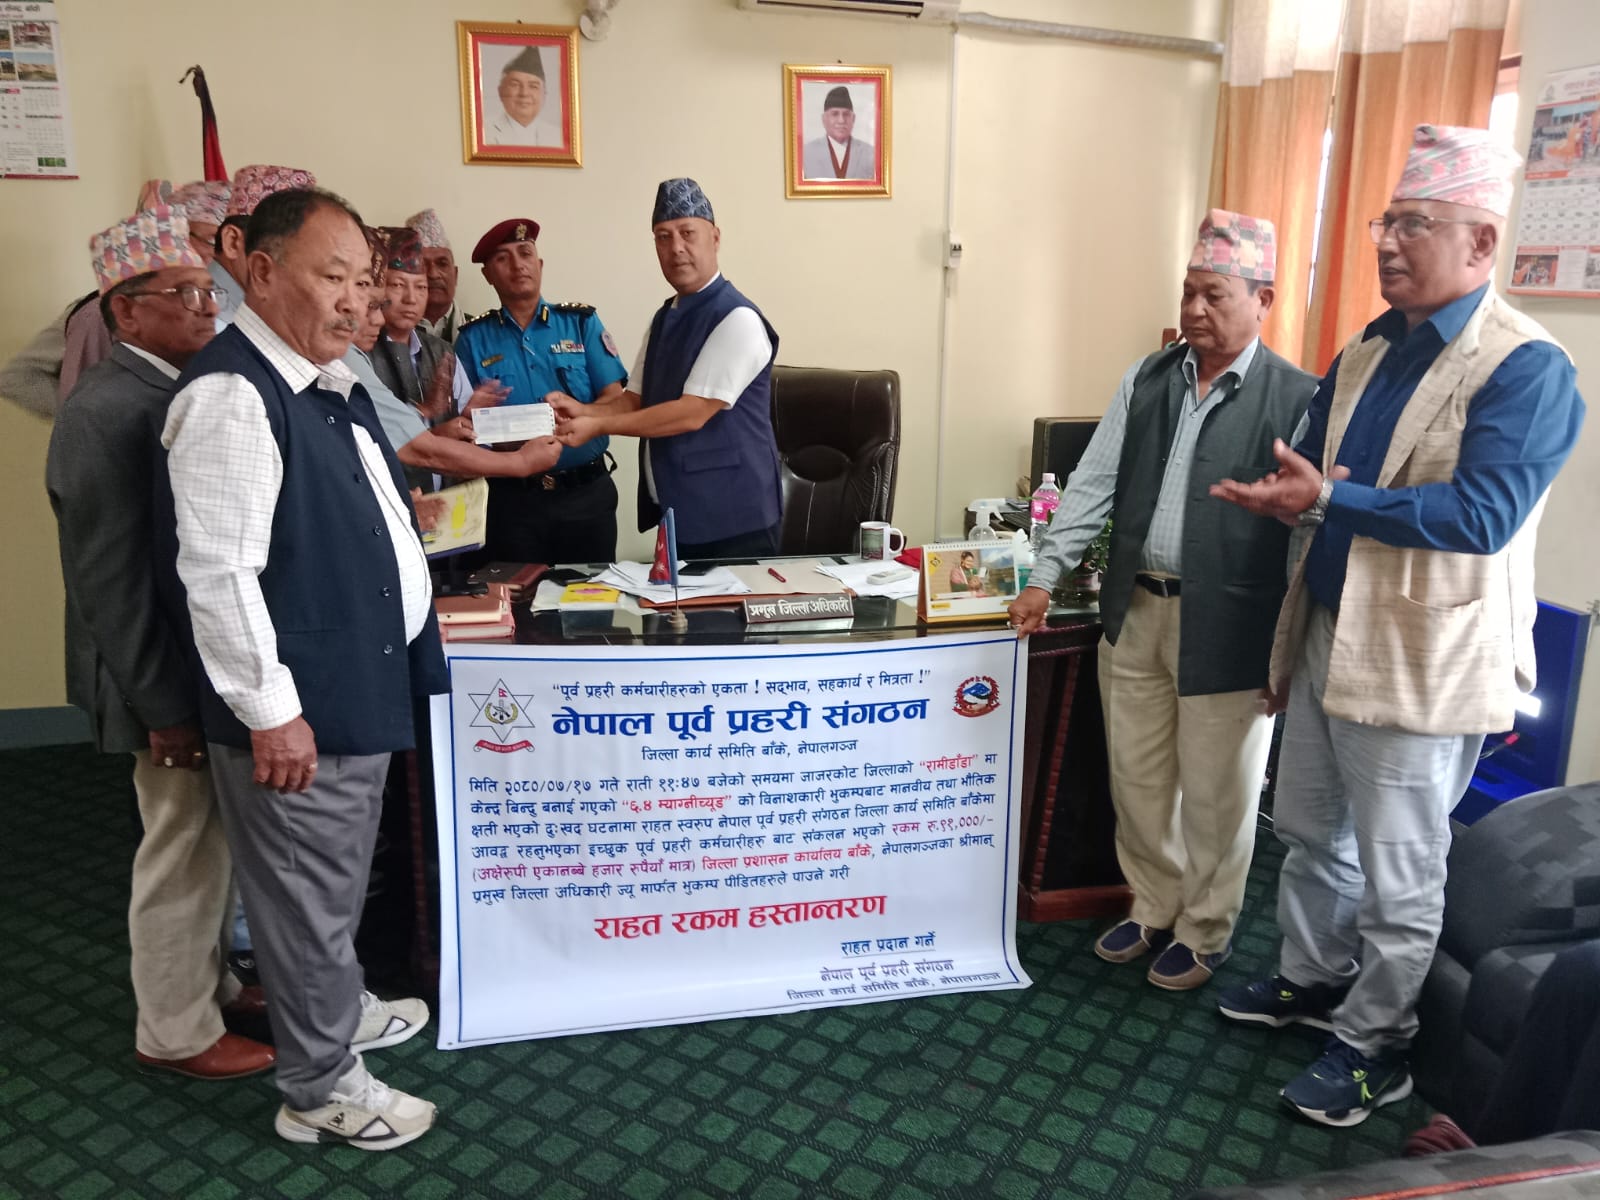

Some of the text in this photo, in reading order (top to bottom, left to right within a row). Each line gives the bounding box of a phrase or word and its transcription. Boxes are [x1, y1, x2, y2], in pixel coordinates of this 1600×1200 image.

[749, 597, 849, 619] प्रमुख जिल्ला अधिकारी
[585, 681, 615, 698] प्रहरी
[621, 681, 706, 698] कर्मचारीहरुको
[712, 683, 748, 698] एकता
[818, 673, 862, 692] सहकार्य
[867, 676, 875, 688] र
[880, 671, 913, 686] मित्रता
[552, 698, 930, 740] नेपाल पूर्व प्रहरी संगठन
[642, 739, 858, 761] जिल्ला कार्य समिति बाँके, नेपालगञ्ज
[469, 777, 498, 793] मिति
[505, 779, 591, 796] २०८०/०७/१७
[600, 777, 620, 792] गते
[627, 775, 653, 792] राती
[659, 776, 700, 792] ११:४७
[708, 772, 745, 787] बजेको
[752, 772, 795, 787] समयमा
[800, 765, 859, 782] जाजरकोट
[864, 760, 914, 777] जिल्लाको
[985, 753, 998, 765] मा
[471, 799, 501, 815] केन्द्र
[506, 799, 537, 817] बिन्दु
[542, 798, 575, 814] बनाई
[580, 798, 617, 815] गएको
[738, 792, 755, 806] को
[759, 787, 826, 806] विनाशकारी
[830, 785, 886, 803] भुकम्पबाट
[890, 779, 932, 795] मानवीय
[936, 778, 958, 790] तथा
[961, 772, 997, 787] भौतिक
[472, 820, 498, 838] क्षती
[503, 820, 540, 838] भएको
[588, 821, 637, 834] घटनामा
[642, 820, 672, 834] राहत
[677, 818, 714, 832] स्वरुप
[718, 814, 752, 829] नेपाल
[756, 811, 775, 829] पूर्व
[779, 808, 807, 825] प्रहरी
[812, 807, 851, 823] संगठन
[855, 803, 889, 818] जिल्ला
[893, 798, 919, 813] कार्य
[922, 795, 957, 813] समिति
[960, 791, 996, 806] बाँकेमा
[516, 844, 581, 860] रहनुभएका
[588, 842, 629, 858] इच्छुक
[636, 838, 655, 857] पूर्व
[662, 836, 692, 853] प्रहरी
[699, 833, 766, 850] कर्मचारीहरु
[773, 833, 796, 845] बाट
[802, 828, 846, 844] संकलन
[853, 822, 886, 840] भएको
[892, 822, 921, 836] रकम
[532, 862, 586, 880] एकानब्बे
[592, 863, 624, 878] हजार
[630, 858, 665, 876] रुपैयाँ
[669, 860, 696, 873] मात्र)
[702, 855, 738, 870] जिल्ला
[743, 853, 789, 869] प्रशासन
[794, 847, 842, 862] कार्यालय
[848, 842, 875, 859] बाँके,
[881, 838, 954, 855] नेपालगञ्जका
[959, 832, 996, 848] श्रीमान्
[472, 864, 850, 905] प्रमुख जिल्ला अधिकारी ज्यू मार्फत भुकम्प पीडितहरुले पाउने गरी
[594, 894, 887, 940] राहत रकम हस्तान्तरण
[841, 939, 872, 956] राहत
[876, 936, 909, 953] प्रदान
[820, 958, 955, 983] नेपाल पूर्व प्रहरी संगठन
